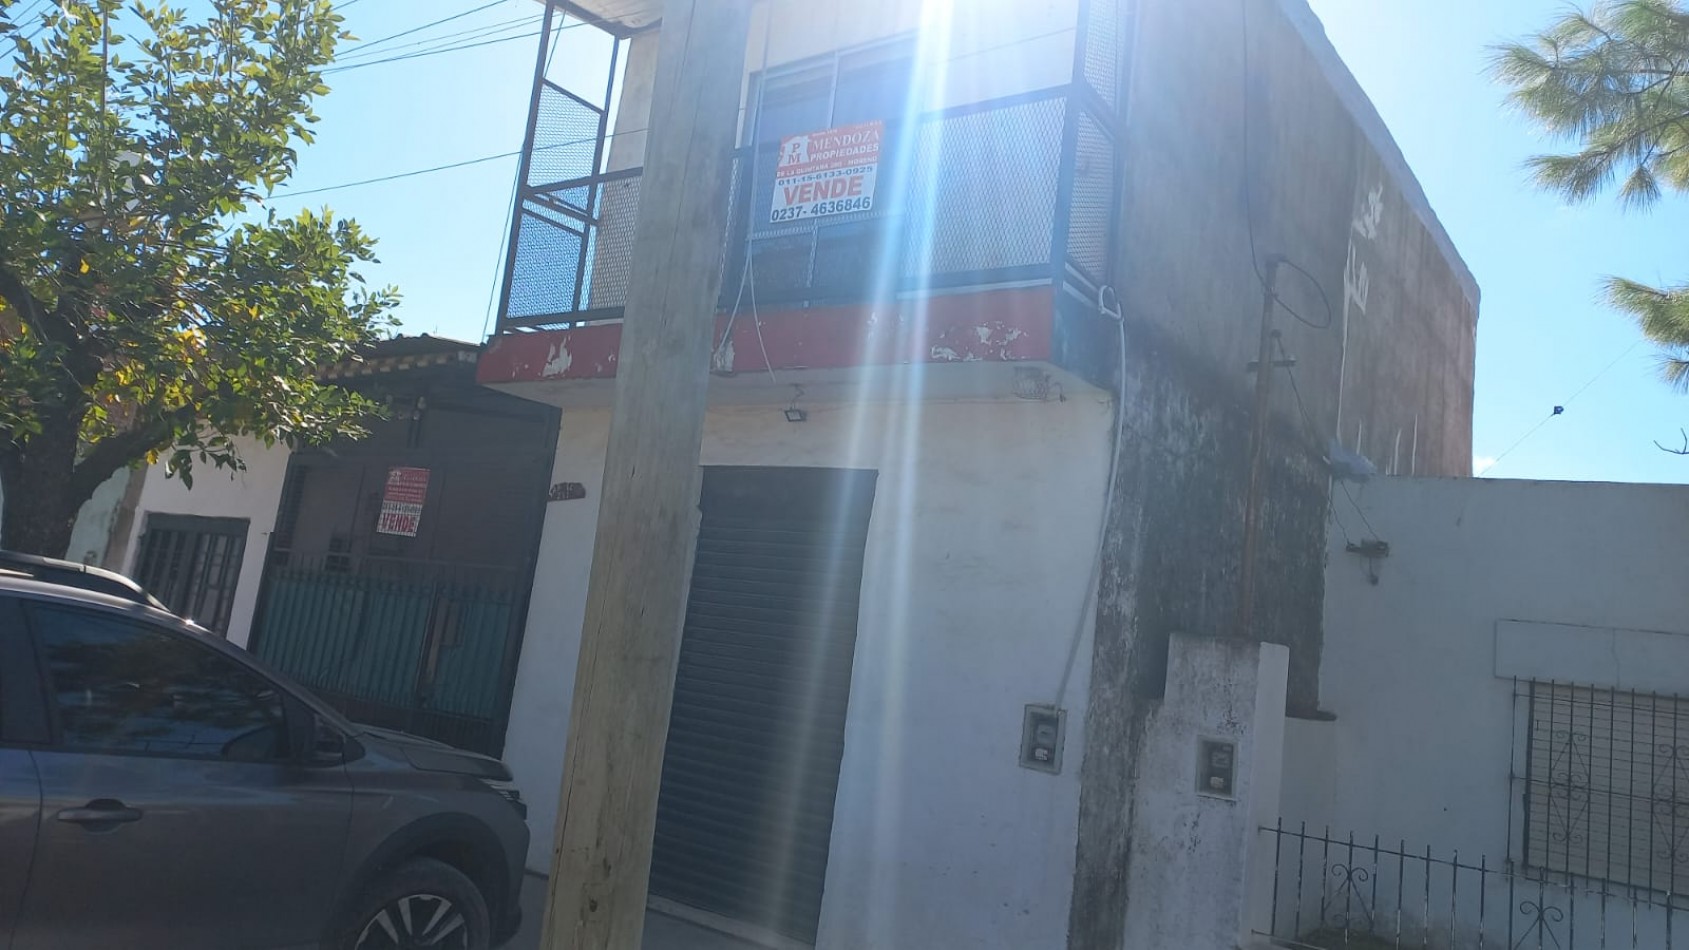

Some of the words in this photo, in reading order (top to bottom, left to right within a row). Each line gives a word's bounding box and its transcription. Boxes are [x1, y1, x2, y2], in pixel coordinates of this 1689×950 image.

[792, 143, 801, 152] P
[812, 130, 880, 151] MENDOZA
[788, 153, 801, 164] M
[810, 143, 880, 162] PROPIEDADES
[783, 175, 864, 206] VENDE
[771, 206, 807, 221] 0237-
[810, 196, 871, 216] 4636846
[382, 513, 416, 533] VENDE
